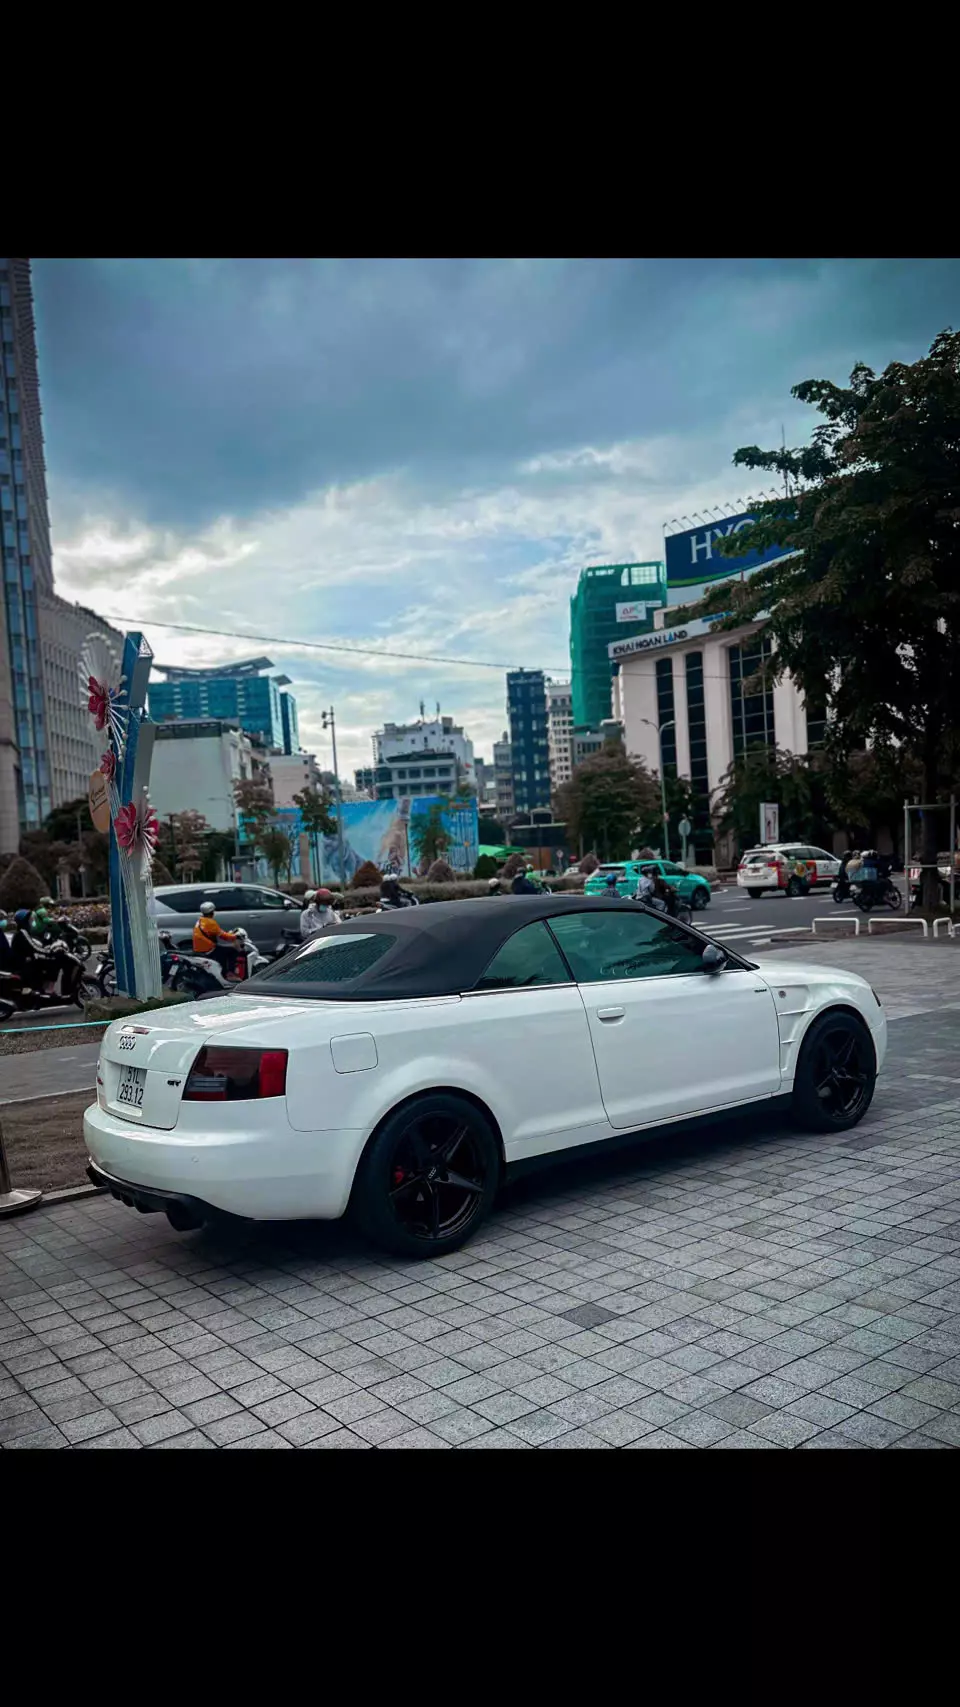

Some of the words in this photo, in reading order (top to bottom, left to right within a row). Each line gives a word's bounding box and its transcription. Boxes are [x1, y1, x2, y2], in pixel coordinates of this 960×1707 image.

[613, 643, 634, 655] KHAI
[635, 635, 661, 649] HOAN
[663, 630, 688, 643] LAND
[127, 1066, 140, 1084] 51L
[119, 1083, 144, 1105] 293.12
